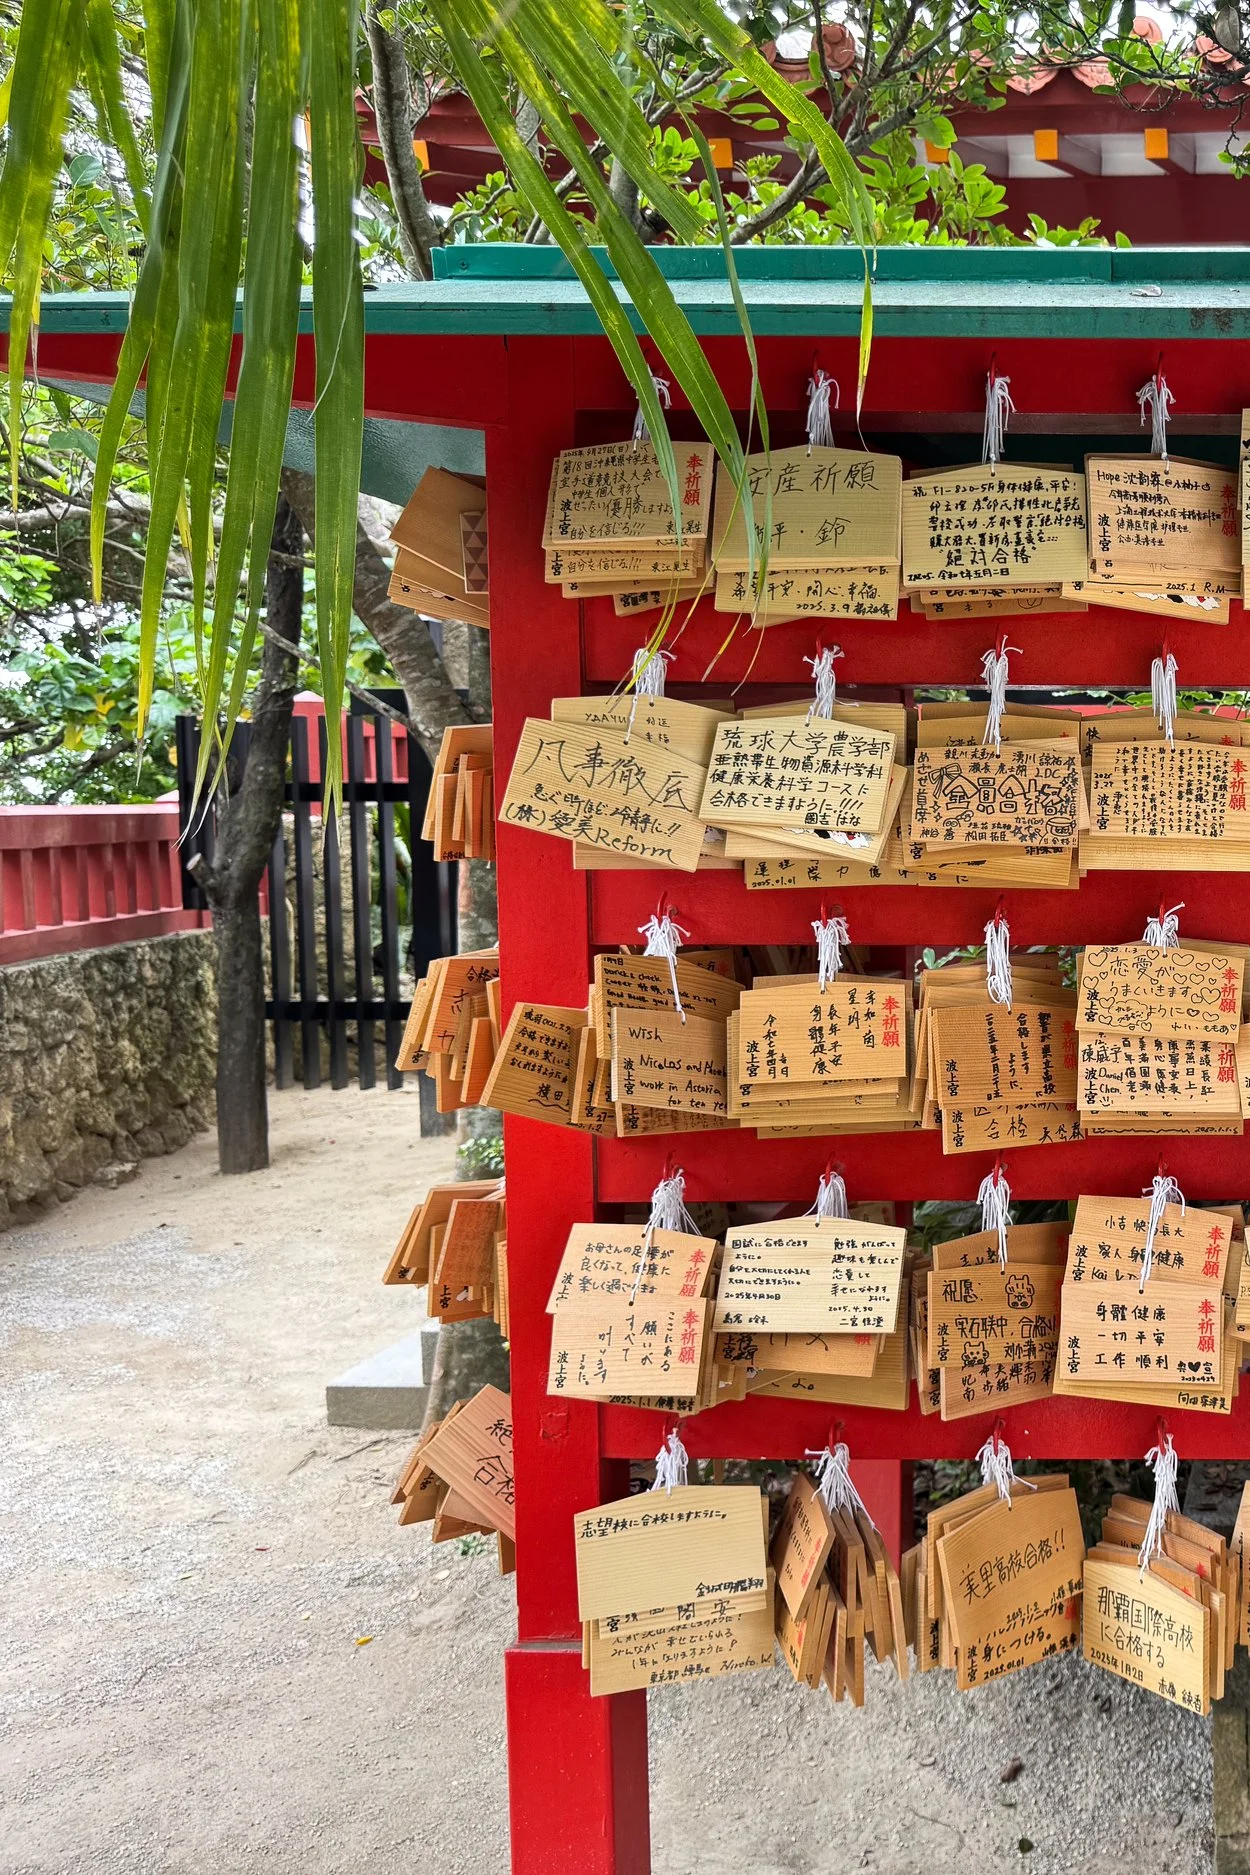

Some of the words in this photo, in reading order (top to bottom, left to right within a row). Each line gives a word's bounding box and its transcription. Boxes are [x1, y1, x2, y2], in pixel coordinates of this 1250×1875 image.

[683, 454, 703, 505] 奉祈願
[1097, 470, 1120, 485] Hope
[559, 499, 572, 535] 波上宮
[1221, 484, 1238, 538] 奉祈願
[1098, 513, 1111, 552] 波上宮
[720, 727, 891, 759] 琉球大学農学部
[709, 768, 870, 796] 健康栄養科学コースに
[714, 752, 883, 779] 亜熱帯生物資源科学科
[1228, 759, 1248, 811] 奉祈願
[1097, 794, 1110, 830] 波上宮
[1110, 955, 1175, 980] 恋愛が
[1085, 990, 1099, 1022] 波上宮
[1110, 981, 1192, 997] うまくいきます
[1219, 967, 1239, 1014] 奉祈願
[881, 996, 900, 1047] 奉祈願
[1147, 1005, 1185, 1017] ように
[629, 1027, 663, 1043] Wish
[1063, 1020, 1076, 1070] 奉祈願
[623, 1057, 634, 1096] 波上宮
[747, 1041, 760, 1077] 波上宮
[640, 1081, 665, 1090] work
[669, 1083, 678, 1091] in
[685, 1080, 722, 1095] Astoria
[945, 1059, 959, 1097] 波上宮
[1084, 1068, 1098, 1104] 波上宮
[668, 1096, 681, 1105] for
[690, 1098, 706, 1108] ten
[952, 1110, 964, 1147] 波上宮
[1072, 1246, 1088, 1281] 波上宮
[1201, 1226, 1225, 1279] 奉祈願
[679, 1248, 706, 1297] 奉祈願
[1096, 1304, 1166, 1322] 身體健康
[1198, 1299, 1217, 1353] 奉祈願
[623, 1315, 636, 1361] すべて
[640, 1321, 657, 1365] 願いが
[661, 1312, 675, 1372] ここにある
[678, 1309, 699, 1364] 奉祈願
[938, 1323, 949, 1361] 波上宮
[1067, 1336, 1081, 1374] 波上宮
[1097, 1330, 1165, 1347] 一切平安
[555, 1351, 568, 1388] 波上宮
[1096, 1354, 1169, 1370] 工作順利
[960, 1528, 1066, 1604] 美里高校合格!!
[1098, 1585, 1194, 1653] 那覇国際高校
[967, 1644, 978, 1682] 波上宮
[1091, 1647, 1144, 1680] 2025年1月2日
[1101, 1624, 1166, 1668] に合格する
